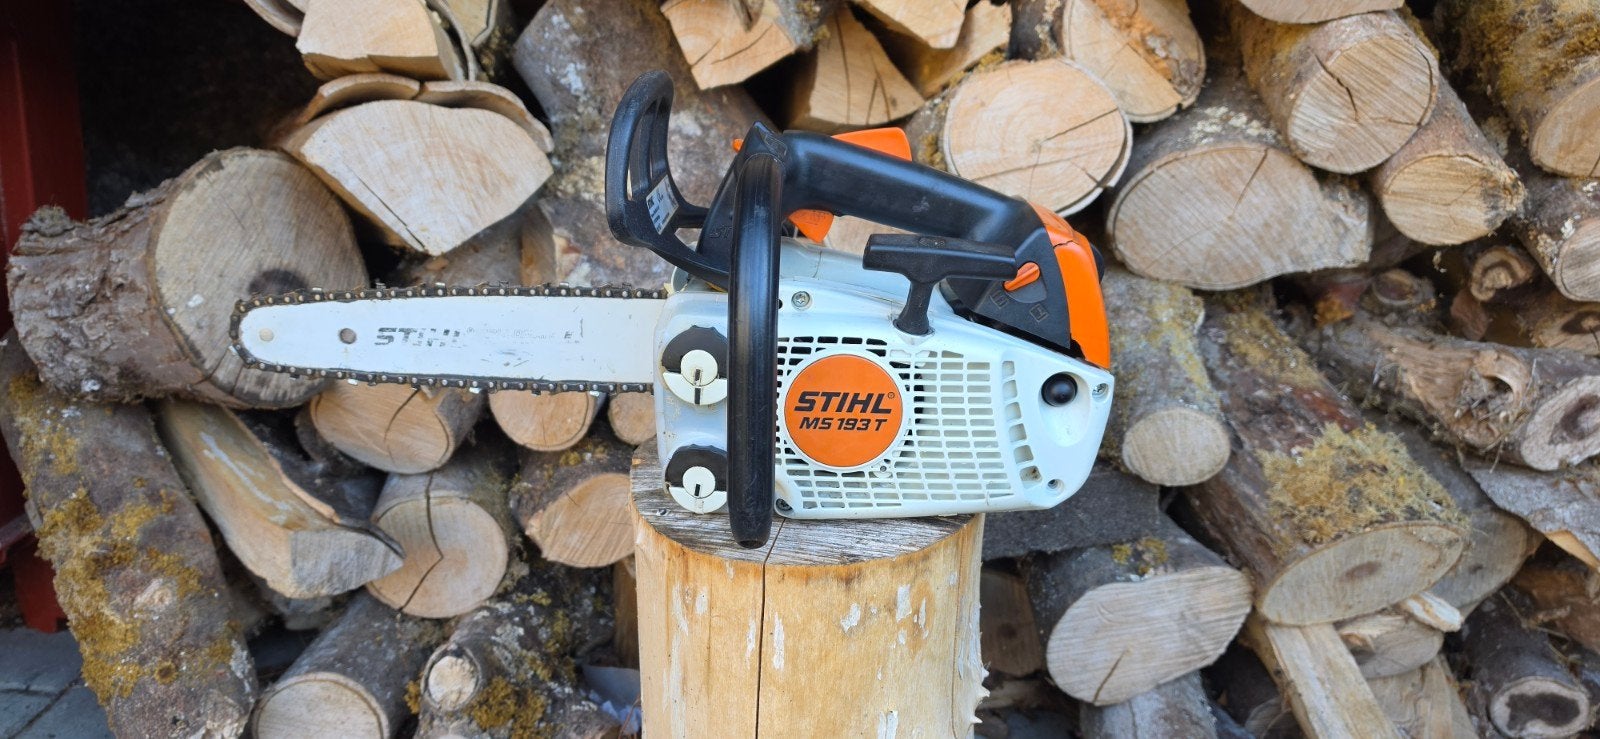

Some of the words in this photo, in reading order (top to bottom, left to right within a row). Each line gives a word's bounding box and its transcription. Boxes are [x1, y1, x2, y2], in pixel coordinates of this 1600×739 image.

[794, 391, 892, 415] STIHL
[799, 416, 834, 430] MS
[837, 418, 872, 431] 193
[875, 418, 888, 431] T
